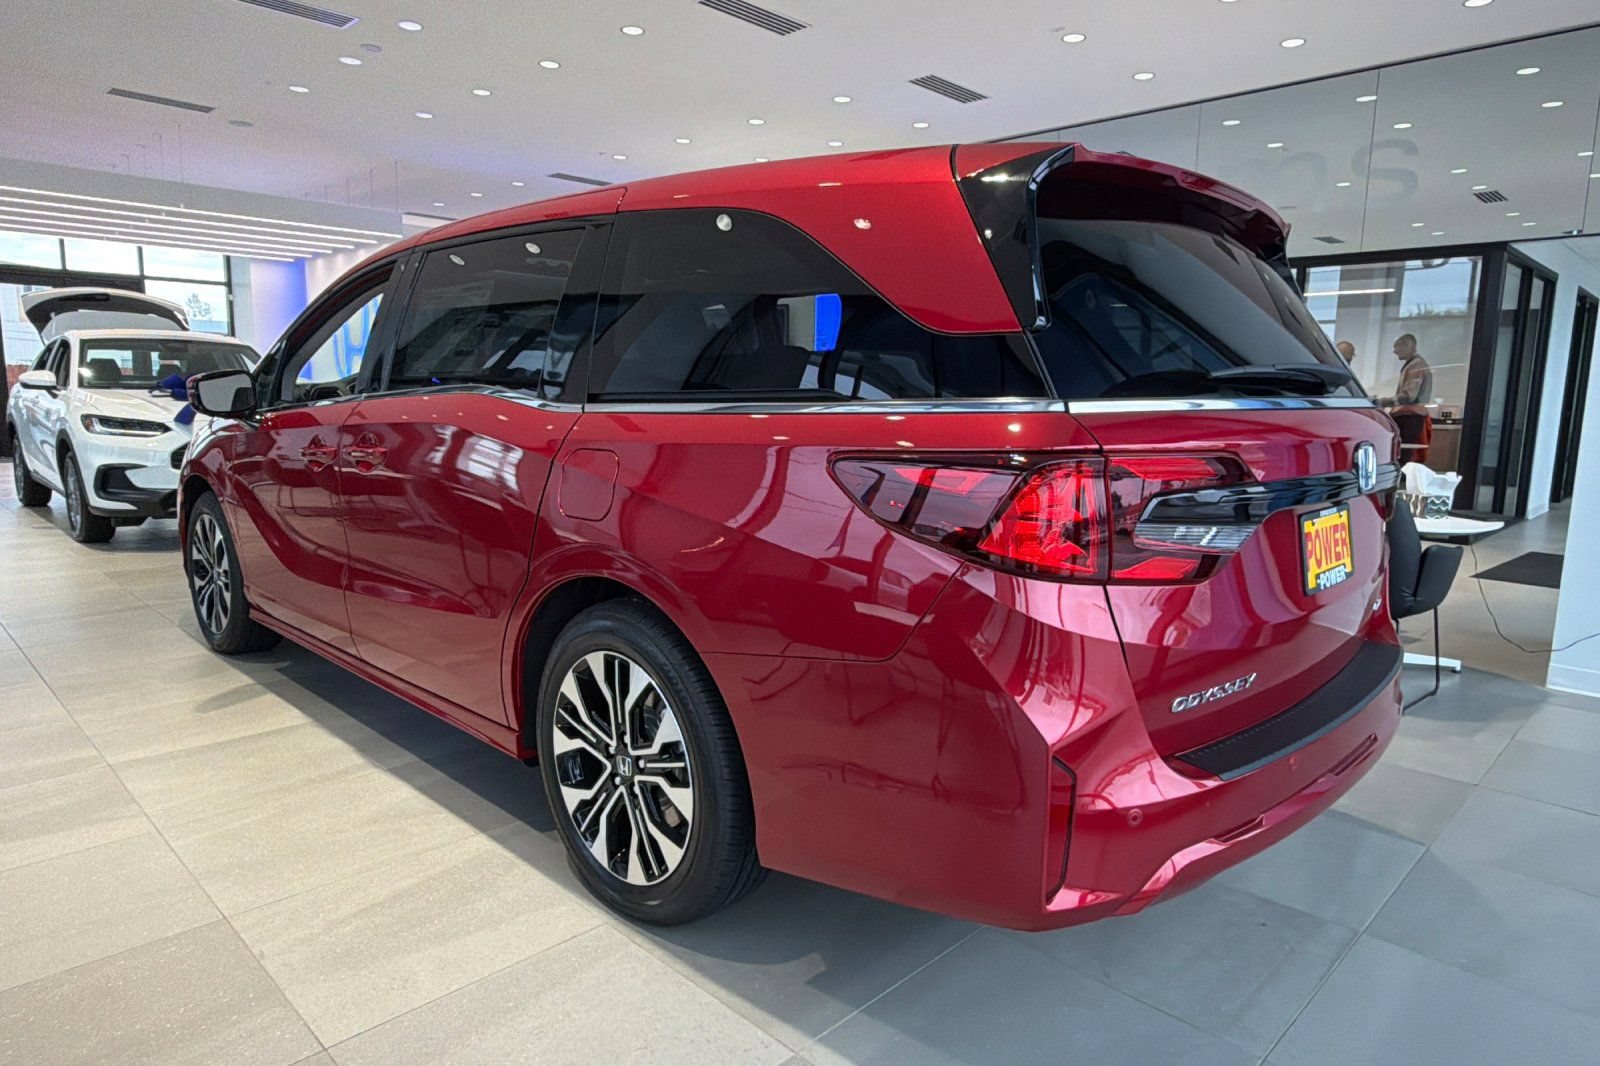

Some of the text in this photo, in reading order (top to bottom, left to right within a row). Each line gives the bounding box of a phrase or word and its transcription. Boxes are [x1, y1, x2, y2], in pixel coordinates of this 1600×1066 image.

[1305, 522, 1350, 572] POWER
[1320, 565, 1346, 590] POWER
[1171, 672, 1257, 713] ODYSSEY
